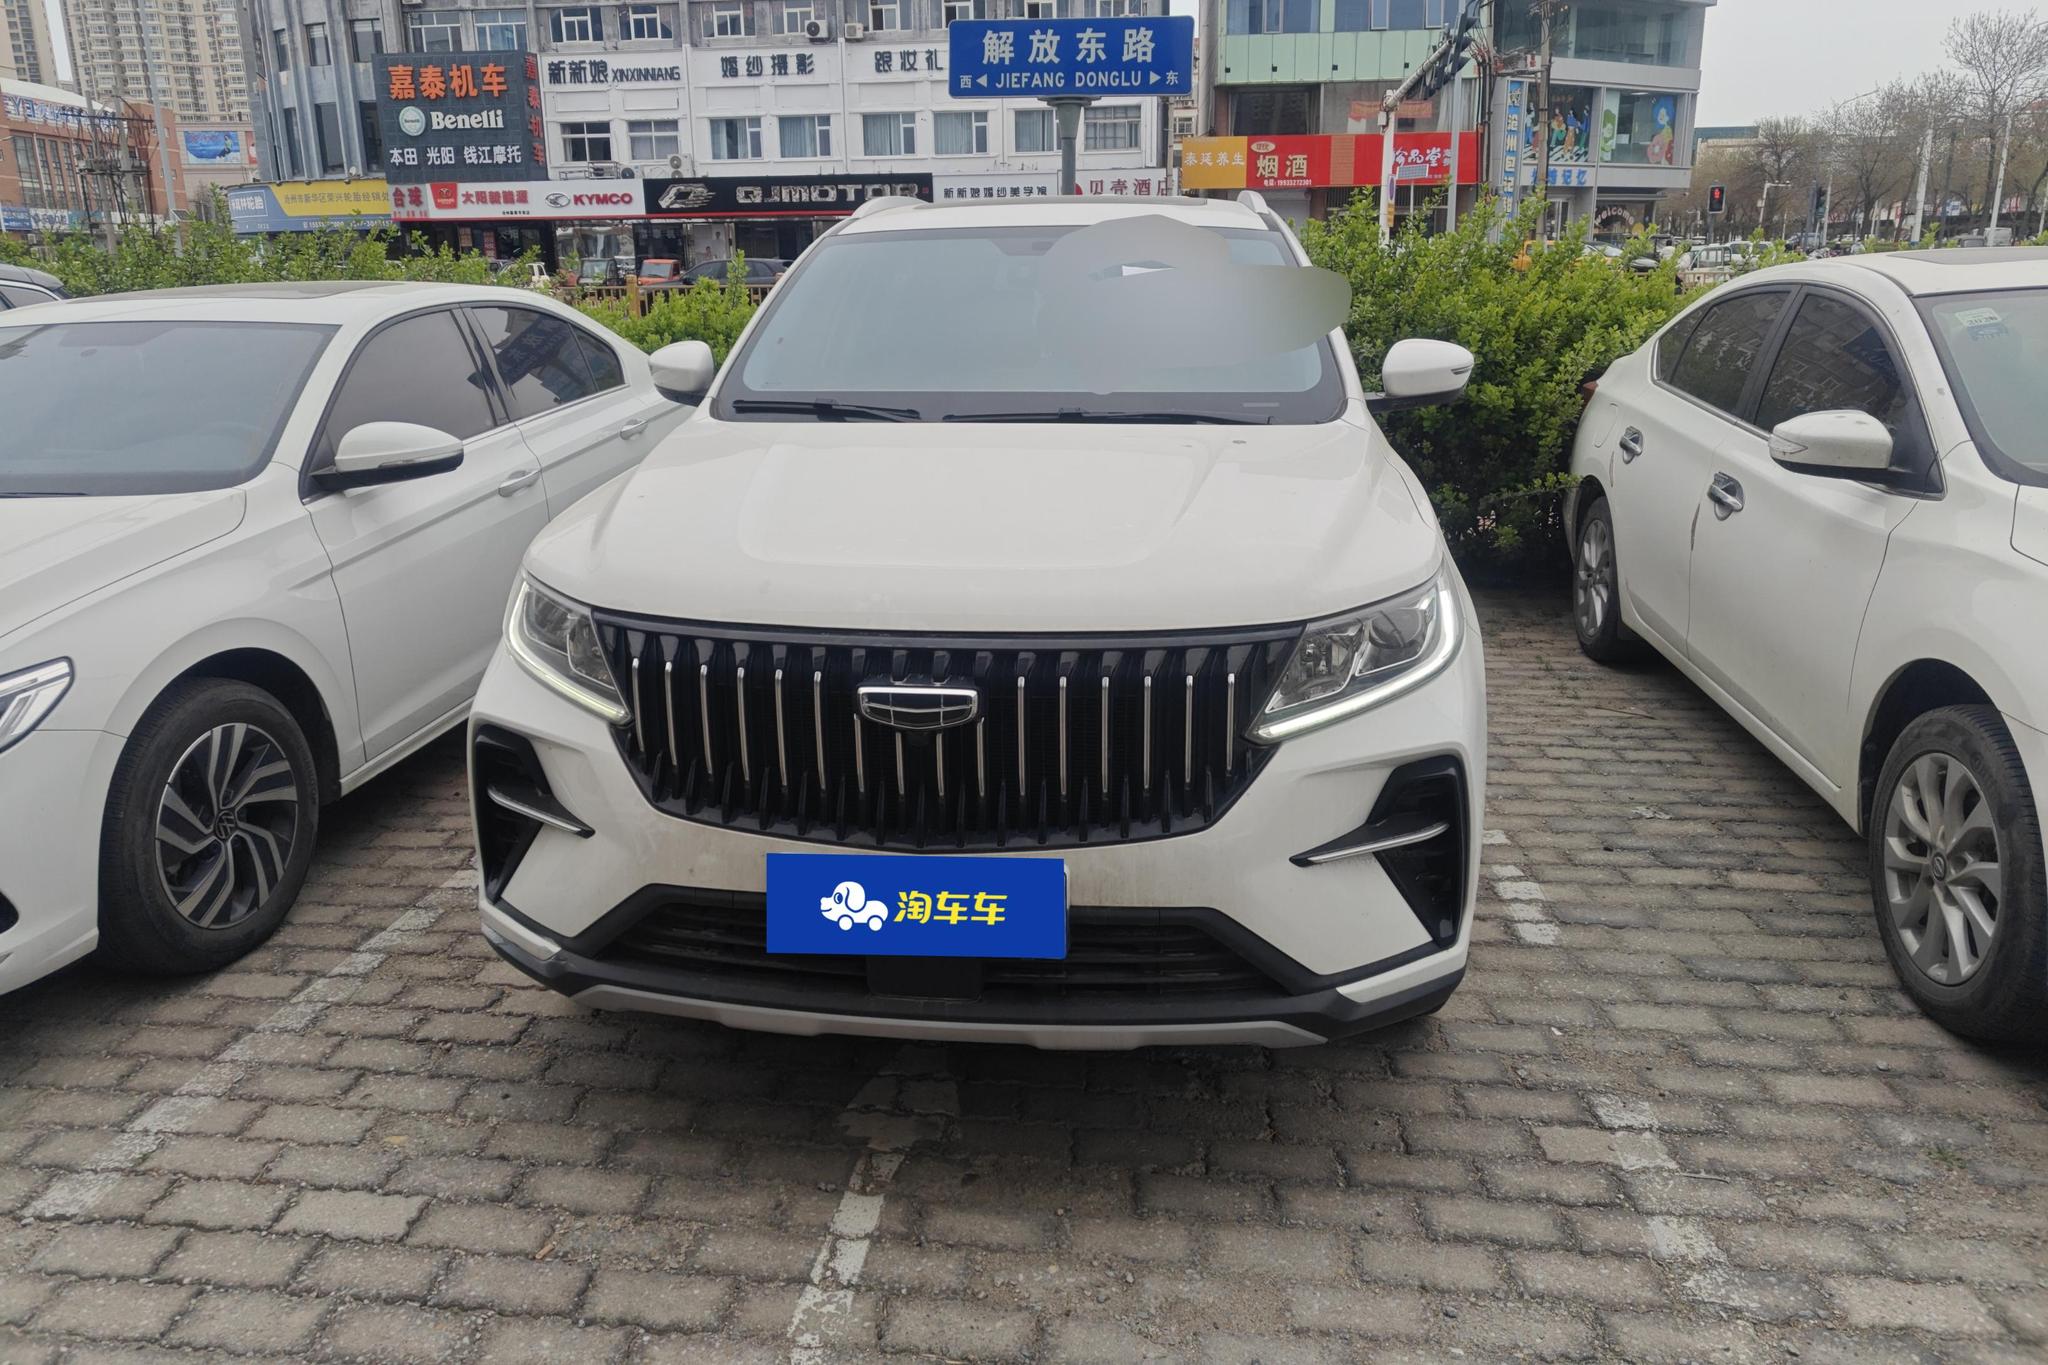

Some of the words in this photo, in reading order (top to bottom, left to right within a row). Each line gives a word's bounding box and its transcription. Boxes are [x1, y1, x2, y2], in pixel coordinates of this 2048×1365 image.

[982, 27, 1156, 65] 解放东路
[548, 59, 609, 84] 新新娘
[611, 66, 681, 82] XINXINNIANG
[721, 53, 815, 78] 婚纱摄影
[387, 63, 509, 100] 嘉泰机车
[960, 75, 972, 89] 西
[995, 72, 1065, 88] JIEFANG
[1075, 71, 1142, 88] DONGLU
[1165, 71, 1179, 86] 东
[431, 110, 504, 130] Benelli
[389, 147, 418, 166] 本田
[426, 146, 455, 165] 光阳
[463, 145, 522, 165] 钱江摩托
[1256, 154, 1308, 178] 烟酒
[393, 186, 424, 208] 台球
[736, 183, 918, 204] QJMOTOR
[1089, 177, 1169, 197] 贝壳酒店
[573, 193, 633, 206] KYMCO
